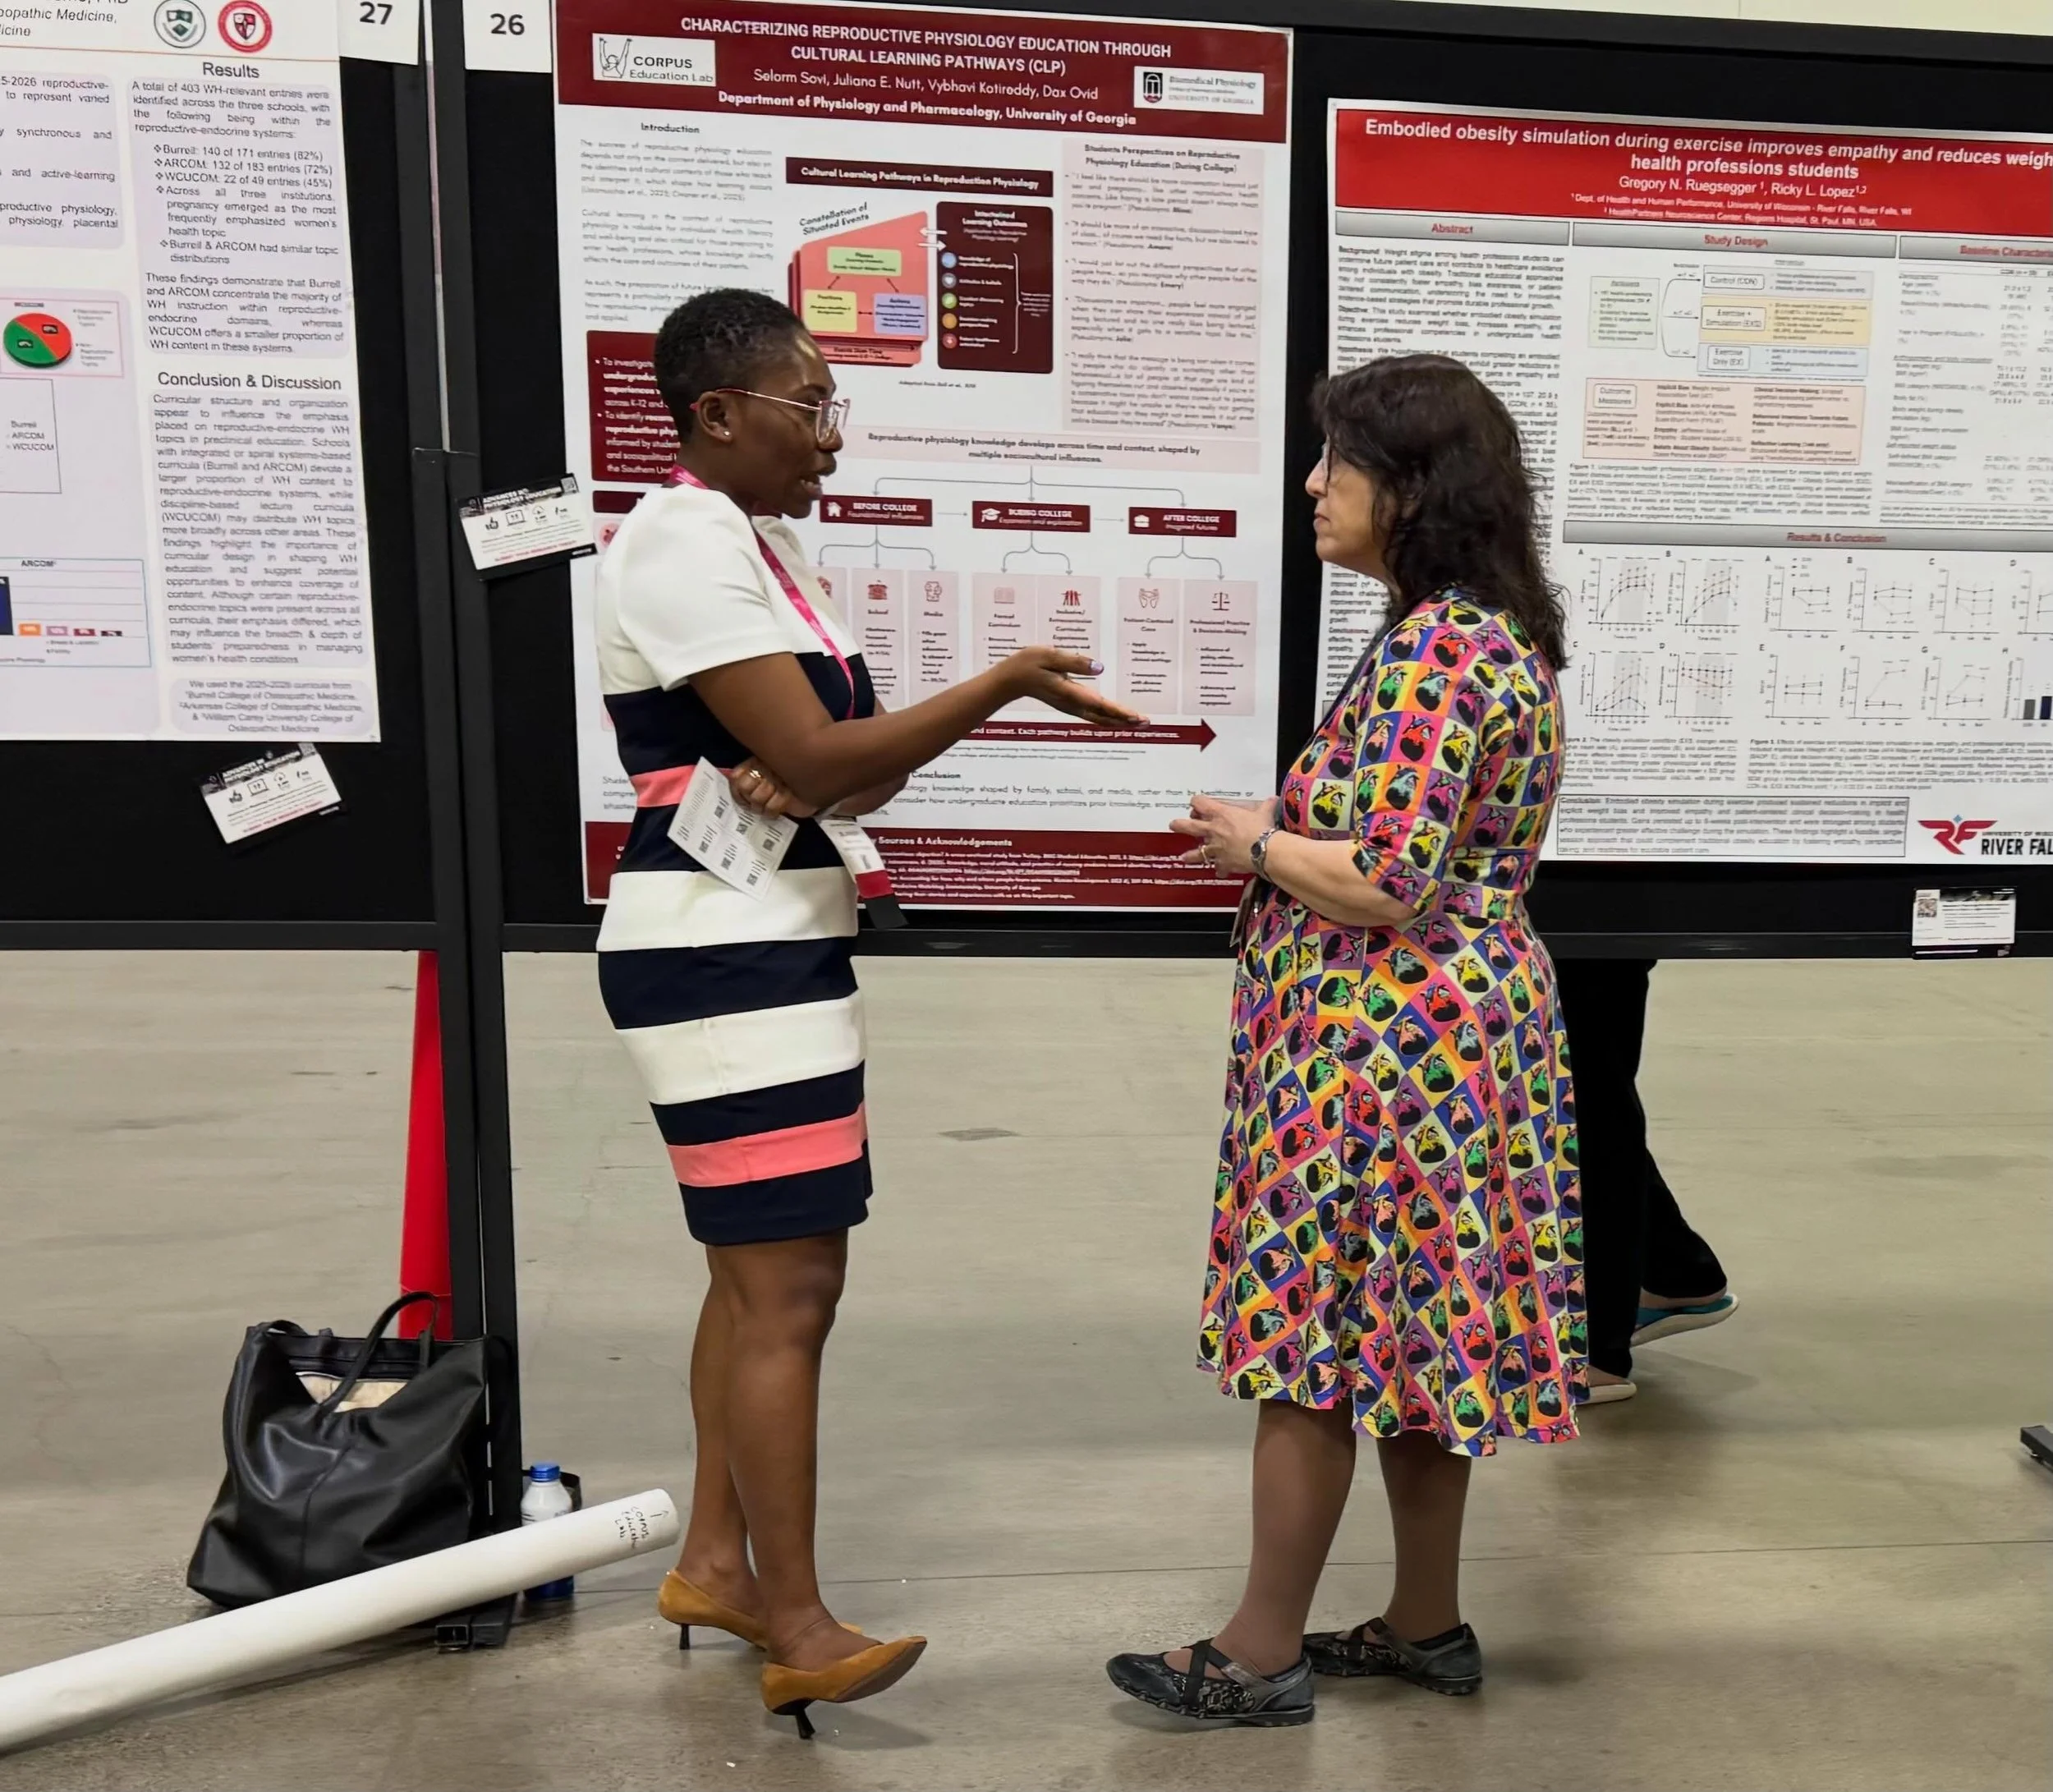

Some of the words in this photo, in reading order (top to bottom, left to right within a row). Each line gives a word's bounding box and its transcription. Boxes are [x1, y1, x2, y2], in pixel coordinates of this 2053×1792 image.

[57, 8, 117, 23] Medicine,
[360, 2, 393, 24] 27
[0, 24, 31, 36] icine
[490, 14, 525, 35] 26
[681, 18, 808, 36] CHARACTERIZING
[812, 25, 921, 43] REPRODUCTIVE
[925, 32, 1015, 48] PHYSIOLOGY
[1018, 37, 1100, 53] EDUCATION
[1103, 42, 1171, 57] THROUGH
[633, 57, 692, 68] CORPUS
[791, 47, 866, 62] CULTURAL
[870, 51, 941, 66] LEARNING
[944, 55, 1025, 71] PATHWAYS
[1028, 59, 1066, 76] (CLP)
[203, 62, 259, 78] Results
[629, 70, 688, 80] Education
[691, 74, 714, 82] Lab
[1, 76, 37, 86] 5-2026
[131, 81, 140, 90] A
[142, 83, 164, 91] total
[168, 83, 177, 92] of
[181, 84, 200, 93] 403
[203, 85, 266, 96] WH-relevant
[754, 69, 797, 82] Selorm
[800, 71, 829, 85] Sovi,
[834, 74, 876, 87] Juliana
[880, 76, 891, 88] E.
[895, 77, 924, 91] Nutt,
[928, 79, 976, 94] Vybhavi
[979, 82, 1040, 99] Kotireddy,
[1043, 85, 1066, 98] Dax
[1069, 86, 1099, 99] Ovid
[133, 95, 178, 105] identified
[182, 99, 215, 108] across
[218, 100, 235, 108] the
[237, 101, 264, 110] three
[719, 91, 794, 106] Department
[797, 95, 811, 107] of
[813, 97, 880, 113] Physiology
[883, 101, 907, 113] and
[910, 102, 1003, 120] Pharmacology,
[1006, 108, 1068, 123] University
[1069, 110, 1083, 122] of
[1086, 112, 1137, 126] Georgia
[133, 109, 150, 118] the
[167, 110, 211, 122] following
[227, 114, 255, 125] being
[641, 123, 700, 133] Introduction
[1366, 119, 1451, 137] Embodied
[1456, 125, 1518, 145] obesity
[1523, 129, 1610, 145] simulation
[1614, 133, 1669, 152] during
[1674, 139, 1743, 152] exercise
[1748, 140, 1823, 156] improves
[1828, 145, 1899, 163] empathy
[1902, 147, 1933, 161] and
[1936, 149, 2001, 163] reduces
[2005, 152, 2053, 169] weigh
[1631, 155, 1682, 170] health
[1686, 159, 1783, 175] professions
[1788, 163, 1859, 178] students
[801, 168, 838, 177] Cultural
[838, 170, 878, 181] Learning
[879, 172, 921, 183] Pathways
[933, 175, 992, 185] Reproduction
[993, 177, 1039, 190] Physiology
[1619, 176, 1666, 191] Gregory
[1669, 178, 1682, 190] N.
[1686, 179, 1757, 195] Ruegsegger
[1771, 182, 1803, 197] Ricky
[800, 210, 856, 227] Constellation
[859, 201, 867, 212] of
[803, 218, 839, 235] Situated
[841, 214, 869, 225] Events
[1431, 224, 1473, 233] Abstract
[1705, 235, 1732, 247] Study
[1734, 237, 1768, 248] Design
[158, 372, 241, 387] Conclusion
[246, 374, 257, 387] &
[261, 375, 342, 389] Discussion
[912, 770, 961, 779] Conclusion
[925, 838, 1013, 847] Acknowledgements
[1982, 839, 2023, 854] RIVER
[2030, 839, 2053, 855] FAL
